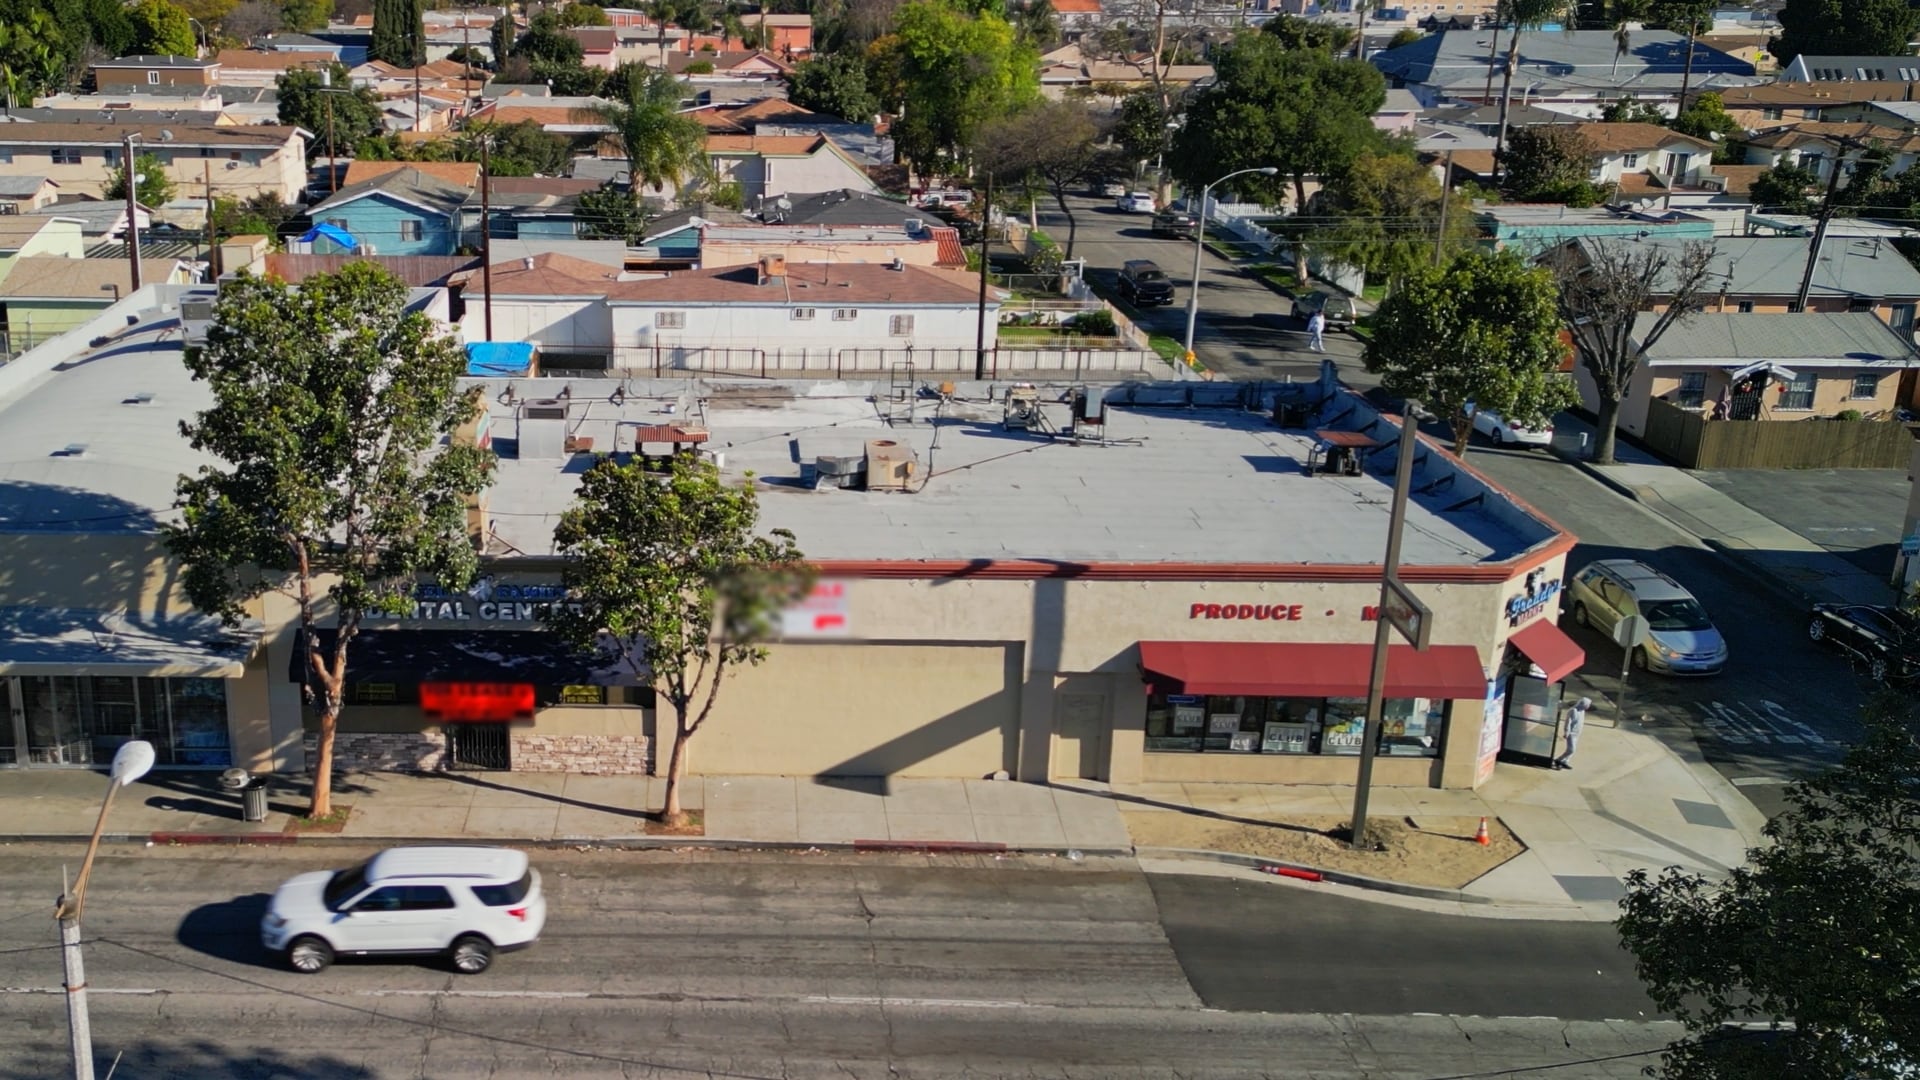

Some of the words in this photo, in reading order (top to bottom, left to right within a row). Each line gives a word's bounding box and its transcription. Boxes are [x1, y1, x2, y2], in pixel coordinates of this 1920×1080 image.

[366, 602, 470, 620] DNTAL
[479, 602, 583, 620] CENER
[1190, 603, 1303, 620] PRODUCE
[1269, 732, 1303, 743] CLUB
[1328, 736, 1362, 746] CLUB
